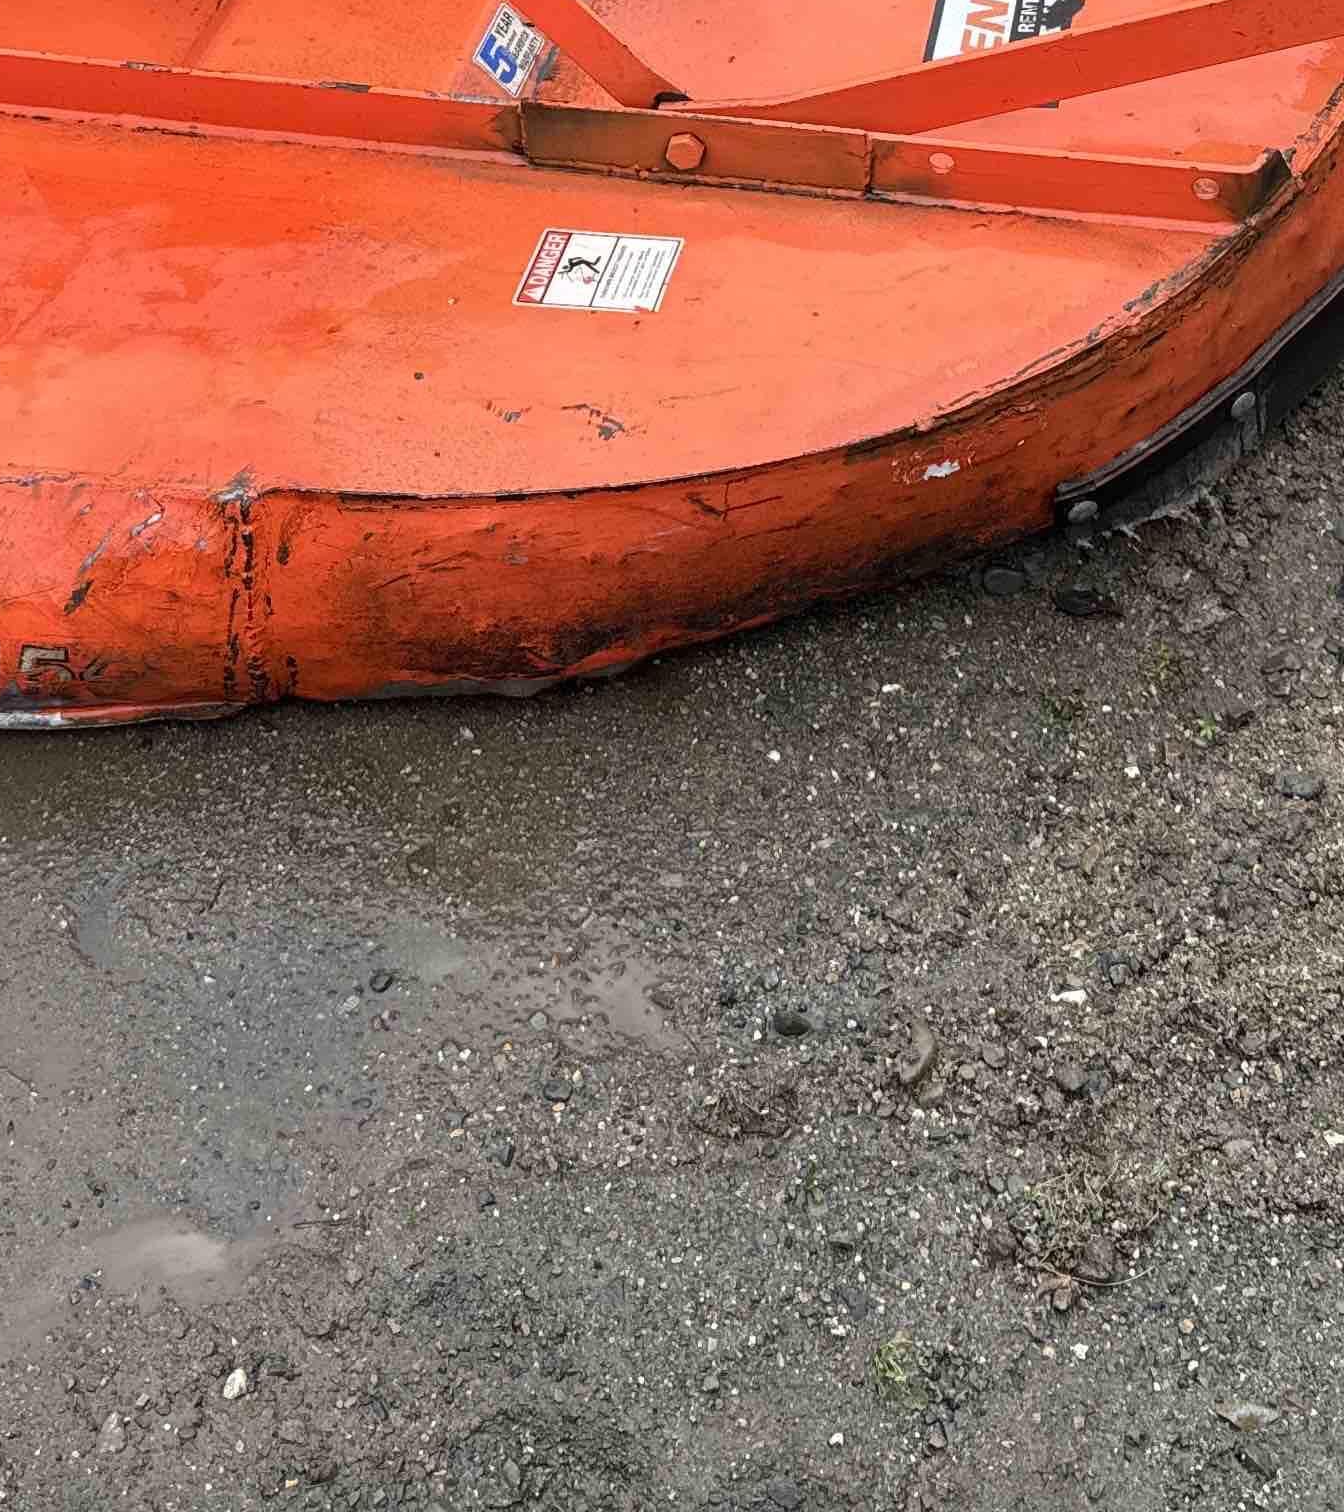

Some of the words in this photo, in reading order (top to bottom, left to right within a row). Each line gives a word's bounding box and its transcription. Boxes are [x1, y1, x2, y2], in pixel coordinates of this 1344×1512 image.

[494, 11, 513, 37] YEAR
[479, 33, 517, 84] 5
[533, 234, 565, 285] DANGER
